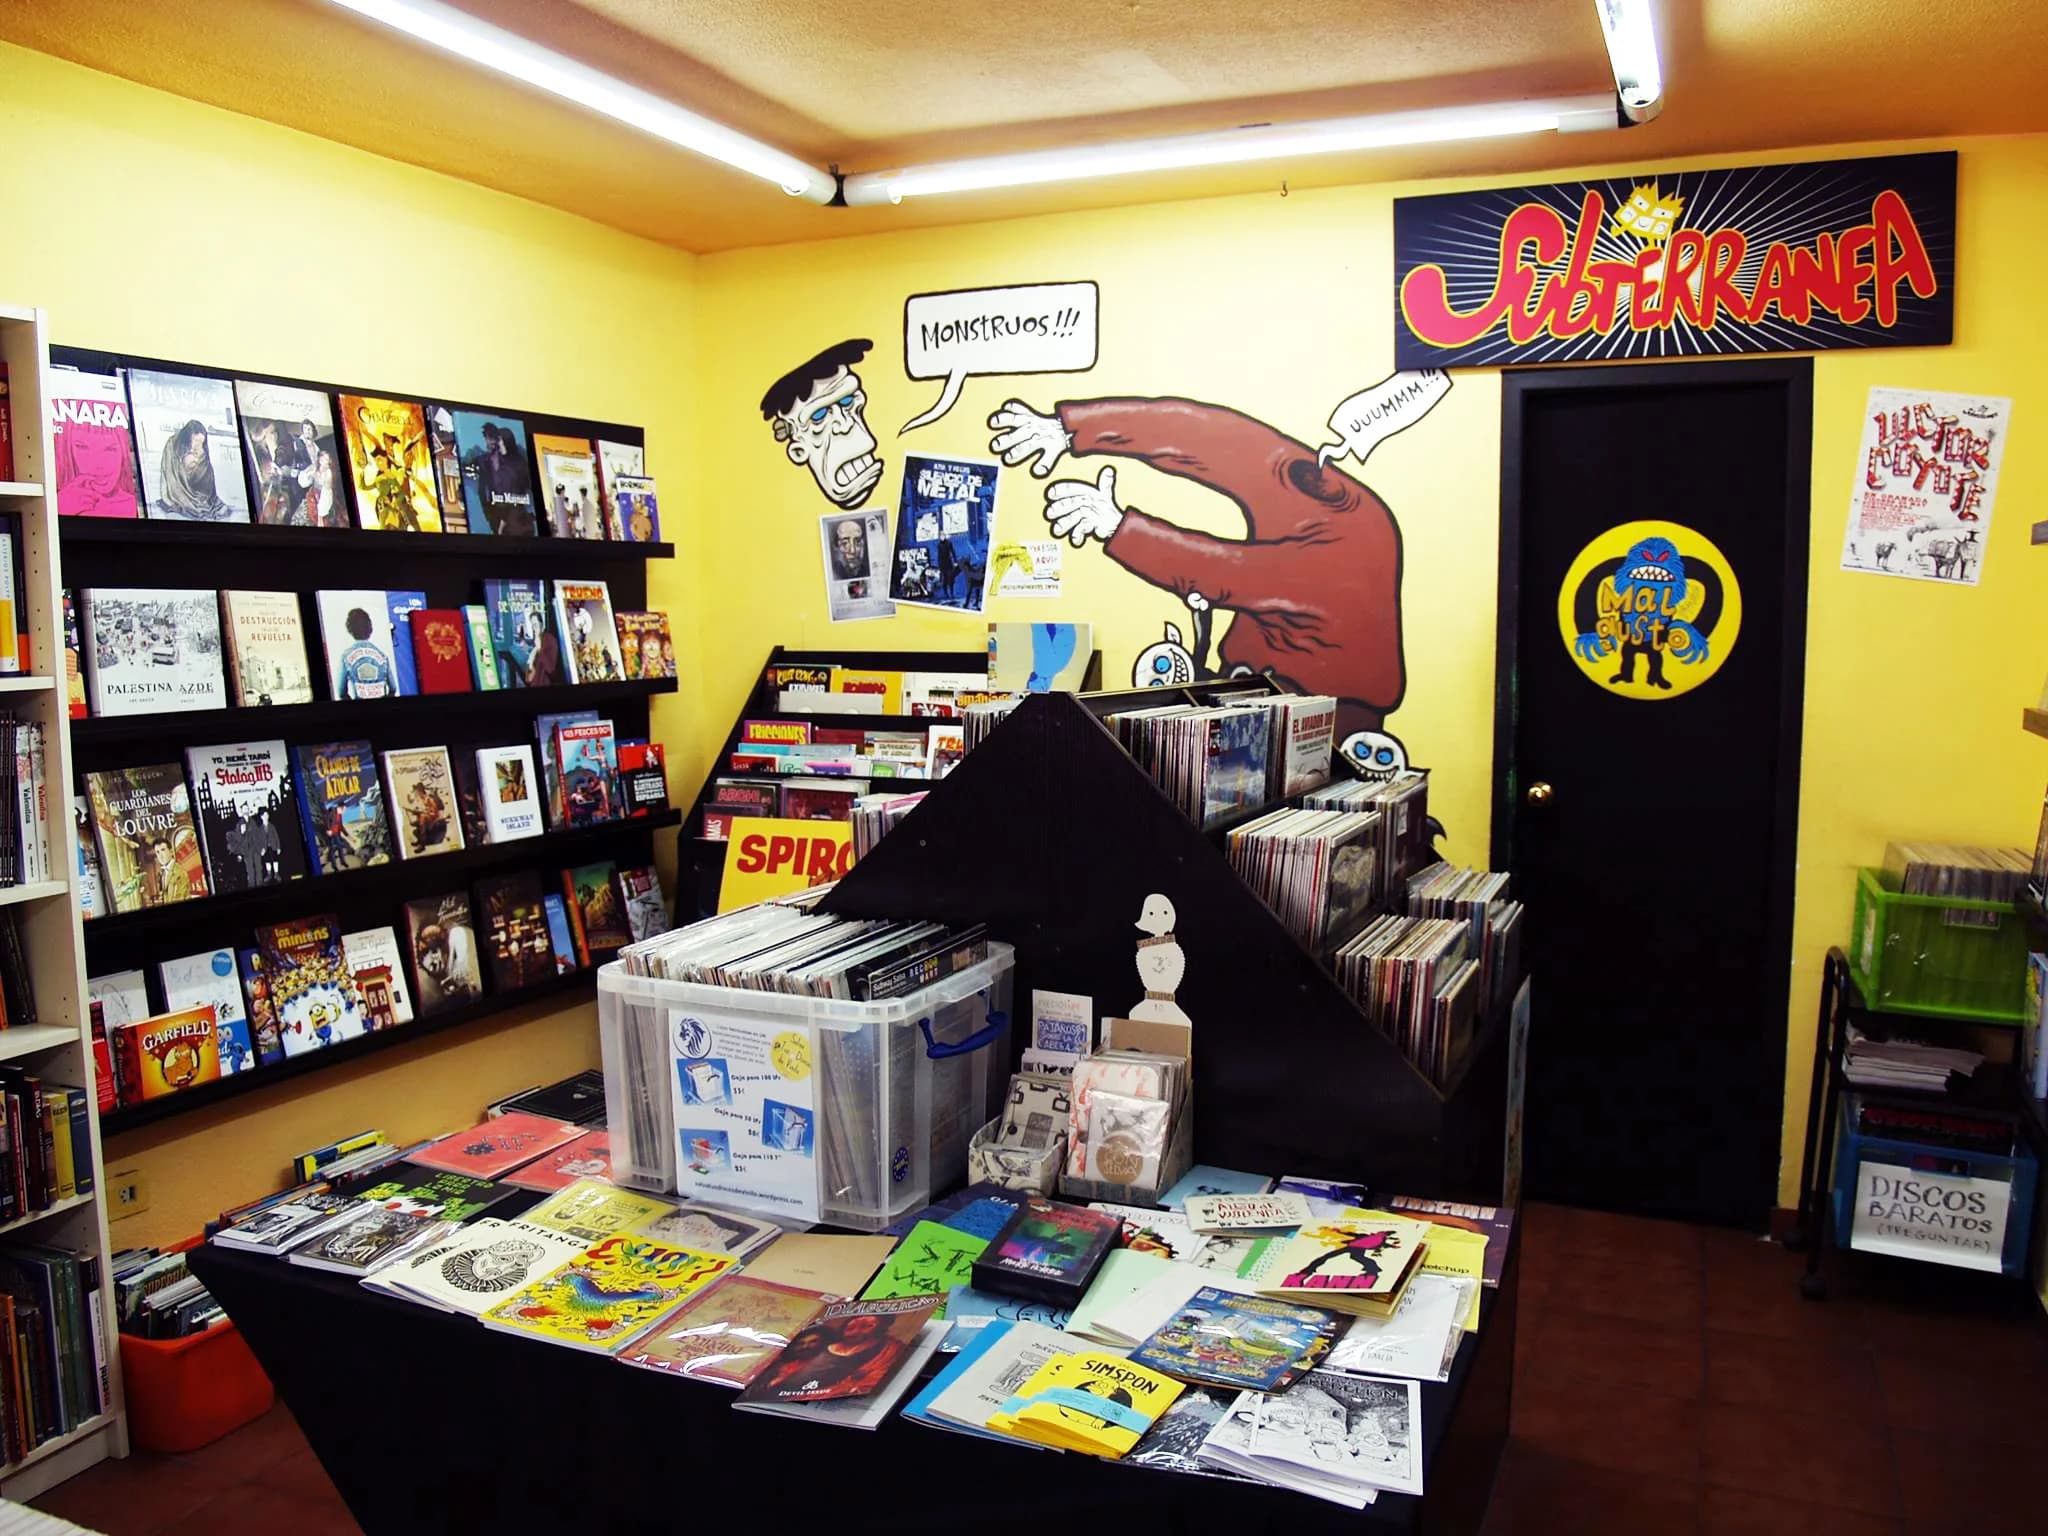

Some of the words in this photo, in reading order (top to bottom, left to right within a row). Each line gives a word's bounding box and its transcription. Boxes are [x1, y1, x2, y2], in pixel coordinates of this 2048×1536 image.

[919, 468, 963, 486] SILENCIO
[968, 474, 983, 487] DE
[917, 480, 981, 503] METAL
[251, 632, 292, 642] REVUELTA
[107, 683, 173, 695] PALESTINA
[22, 779, 31, 825] Valentina
[37, 783, 46, 822] Valentina
[109, 793, 173, 812] GUARDIANES
[131, 789, 147, 798] LOS
[135, 807, 152, 817] DEL
[114, 812, 177, 837] LOUVRE
[275, 928, 291, 937] los
[278, 926, 330, 950] minions
[143, 1019, 211, 1050] GARFIELD
[1871, 1175, 1986, 1214] DISCOS
[1868, 1201, 1993, 1234] BARATOS
[509, 1221, 589, 1251] FRITANGA
[1080, 1359, 1159, 1395] SIMSPON
